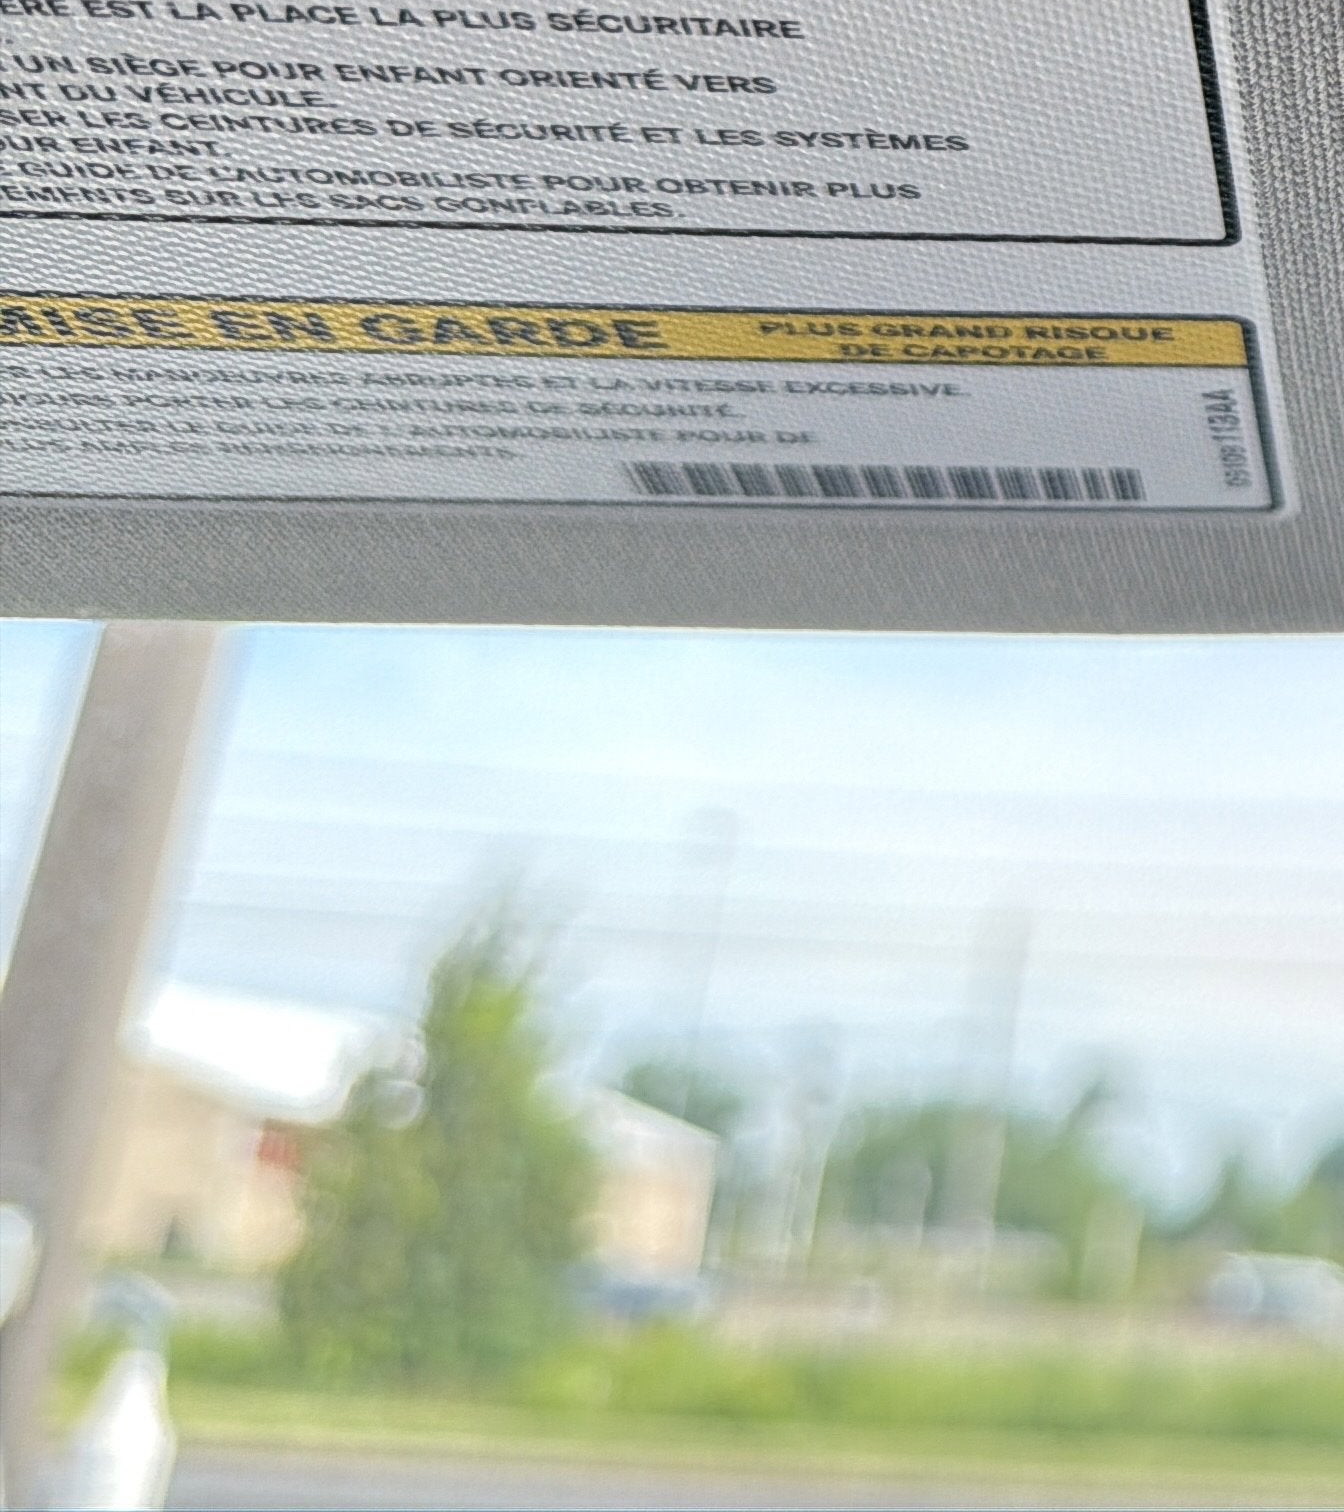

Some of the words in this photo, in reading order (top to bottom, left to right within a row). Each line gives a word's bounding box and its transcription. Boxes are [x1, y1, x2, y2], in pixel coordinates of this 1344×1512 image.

[80, 0, 153, 20] EST
[165, 1, 223, 21] LA
[229, 2, 359, 25] PLACE
[369, 6, 426, 28] LA
[437, 10, 537, 31] PLUS
[548, 8, 804, 40] SÉCURITAIRE
[13, 54, 78, 74] UN
[86, 52, 207, 78] SIÈGE
[213, 59, 324, 81] POUR
[336, 63, 489, 87] ENFANT
[500, 68, 670, 90] ORIENTÉ
[675, 74, 778, 95] VERS
[57, 83, 118, 102] DU
[125, 82, 337, 108] VÉHICULE.
[77, 110, 152, 130] LES
[160, 112, 378, 136] CEINTURES
[386, 119, 443, 138] DE
[448, 118, 634, 143] SÉCURITÉ
[642, 125, 683, 144] ET
[697, 128, 767, 148] LES
[773, 129, 971, 152] SYSTÈMES
[18, 161, 143, 180] GUIDE
[145, 164, 203, 181] DE
[542, 174, 647, 194] POUR
[655, 177, 817, 199] OBTENIR
[825, 181, 923, 201] PLUS
[164, 189, 243, 207] SUR
[250, 191, 321, 209] LES
[328, 192, 425, 212] SACS
[210, 309, 336, 343] EN
[360, 312, 668, 350] GARDE
[757, 321, 864, 337] PLUS
[872, 323, 1013, 340] GRAND
[1024, 325, 1176, 343] RISQUE
[838, 342, 895, 358] DE
[898, 343, 1109, 361] CAPOTAGE
